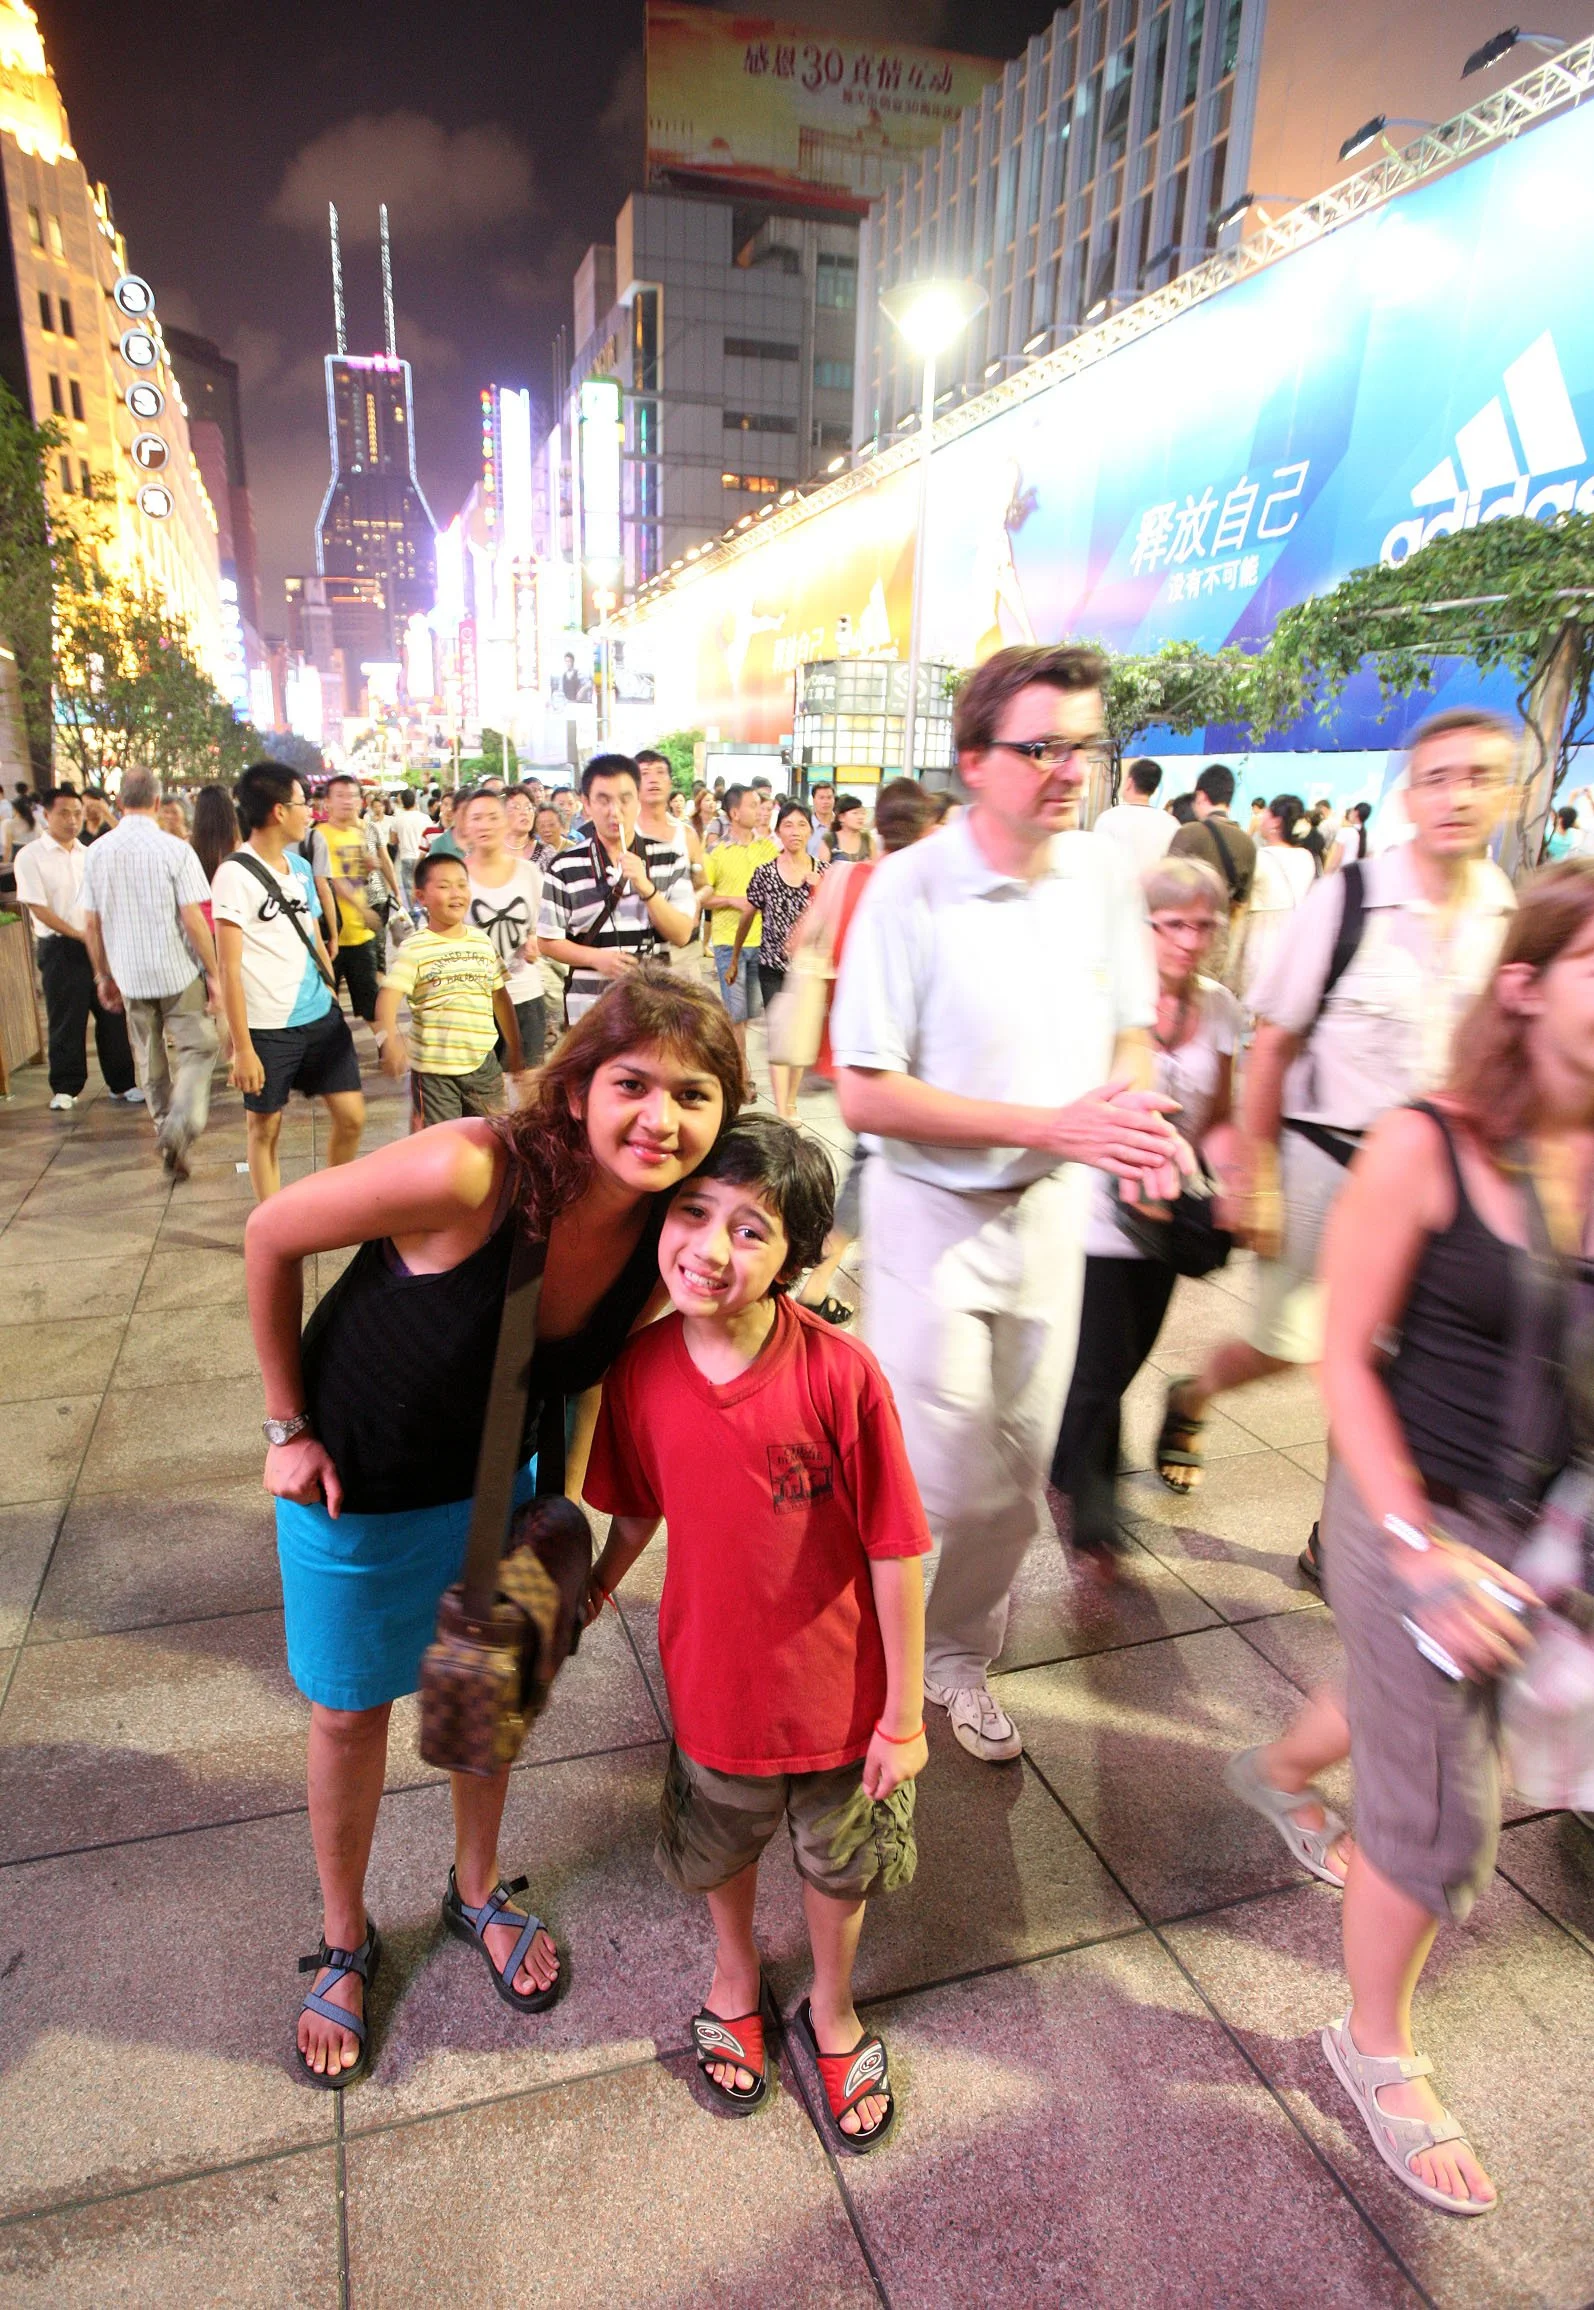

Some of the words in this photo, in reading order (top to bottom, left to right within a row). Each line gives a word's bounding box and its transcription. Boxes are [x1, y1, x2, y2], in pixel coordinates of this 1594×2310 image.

[1130, 459, 1310, 577] 释放自己
[1169, 556, 1260, 601] 没有不可能
